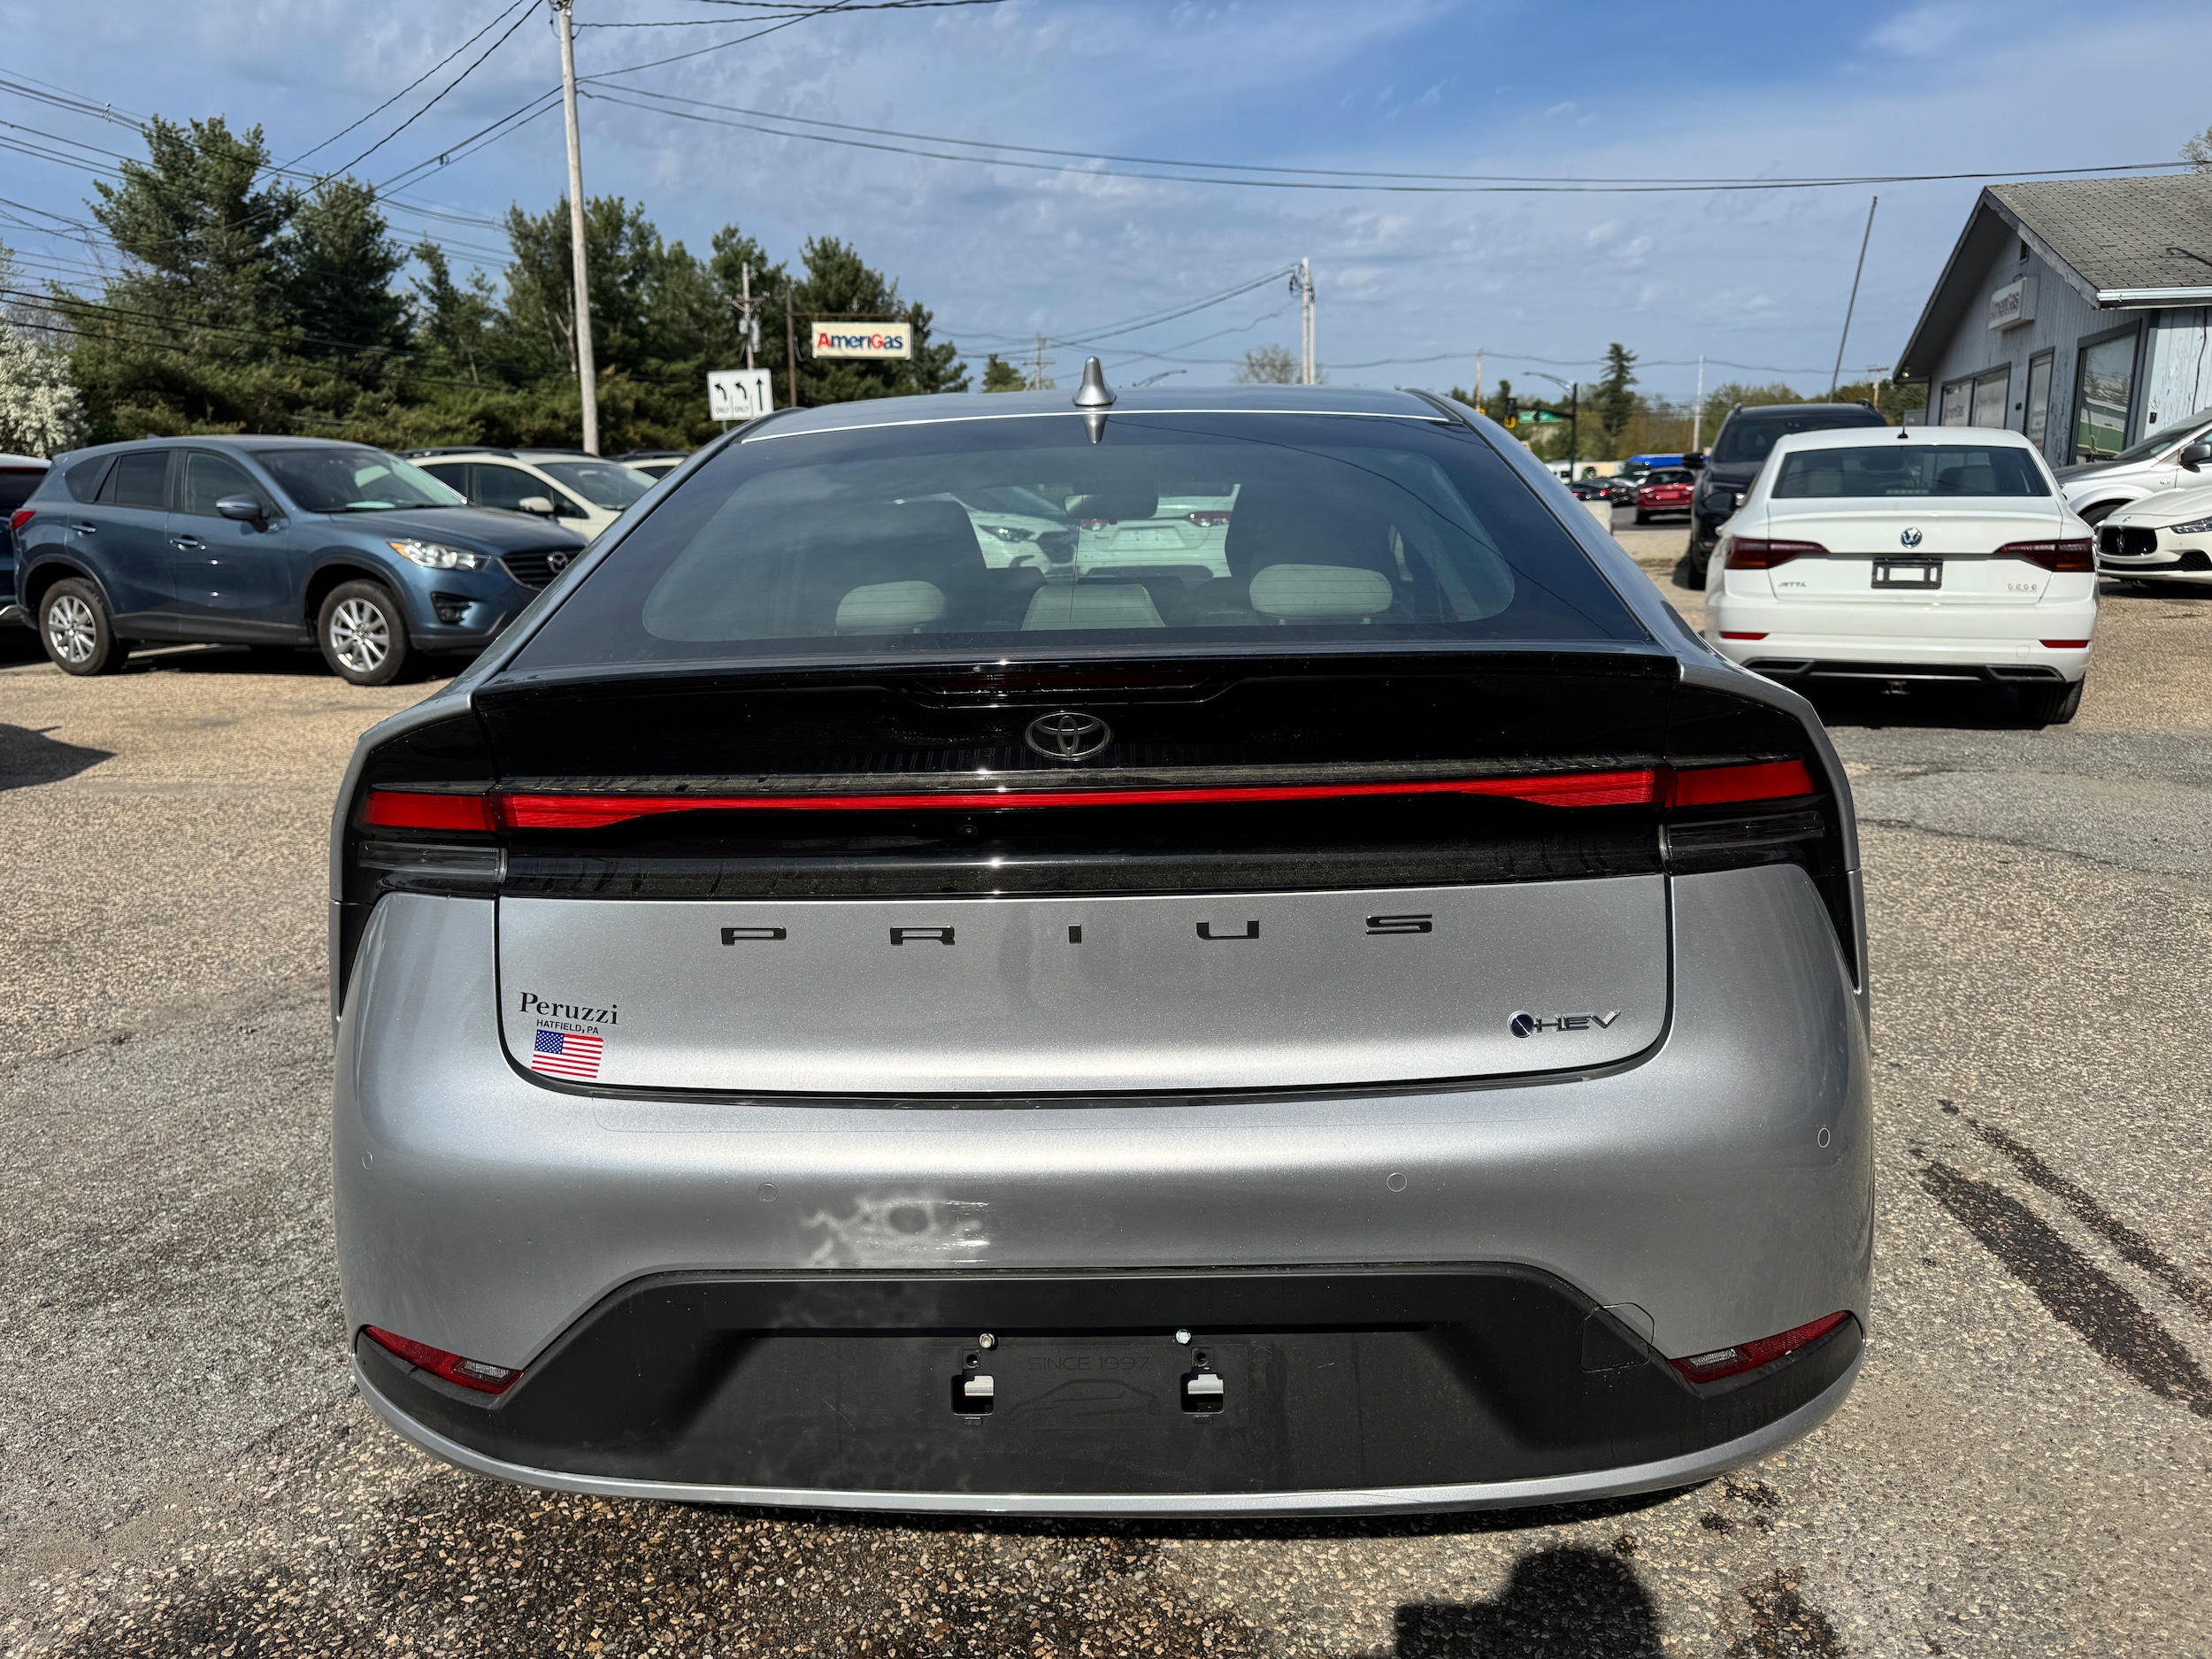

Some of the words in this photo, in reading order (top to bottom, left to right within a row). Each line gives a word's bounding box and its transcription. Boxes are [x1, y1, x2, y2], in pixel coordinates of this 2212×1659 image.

[818, 333, 904, 349] AmeriGas
[720, 914, 1433, 947] PRIUS
[518, 991, 619, 1025] Peruzzi
[536, 1018, 586, 1034] HATFIELD,
[587, 1025, 600, 1034] PA
[1098, 1356, 1150, 1371] 1997
